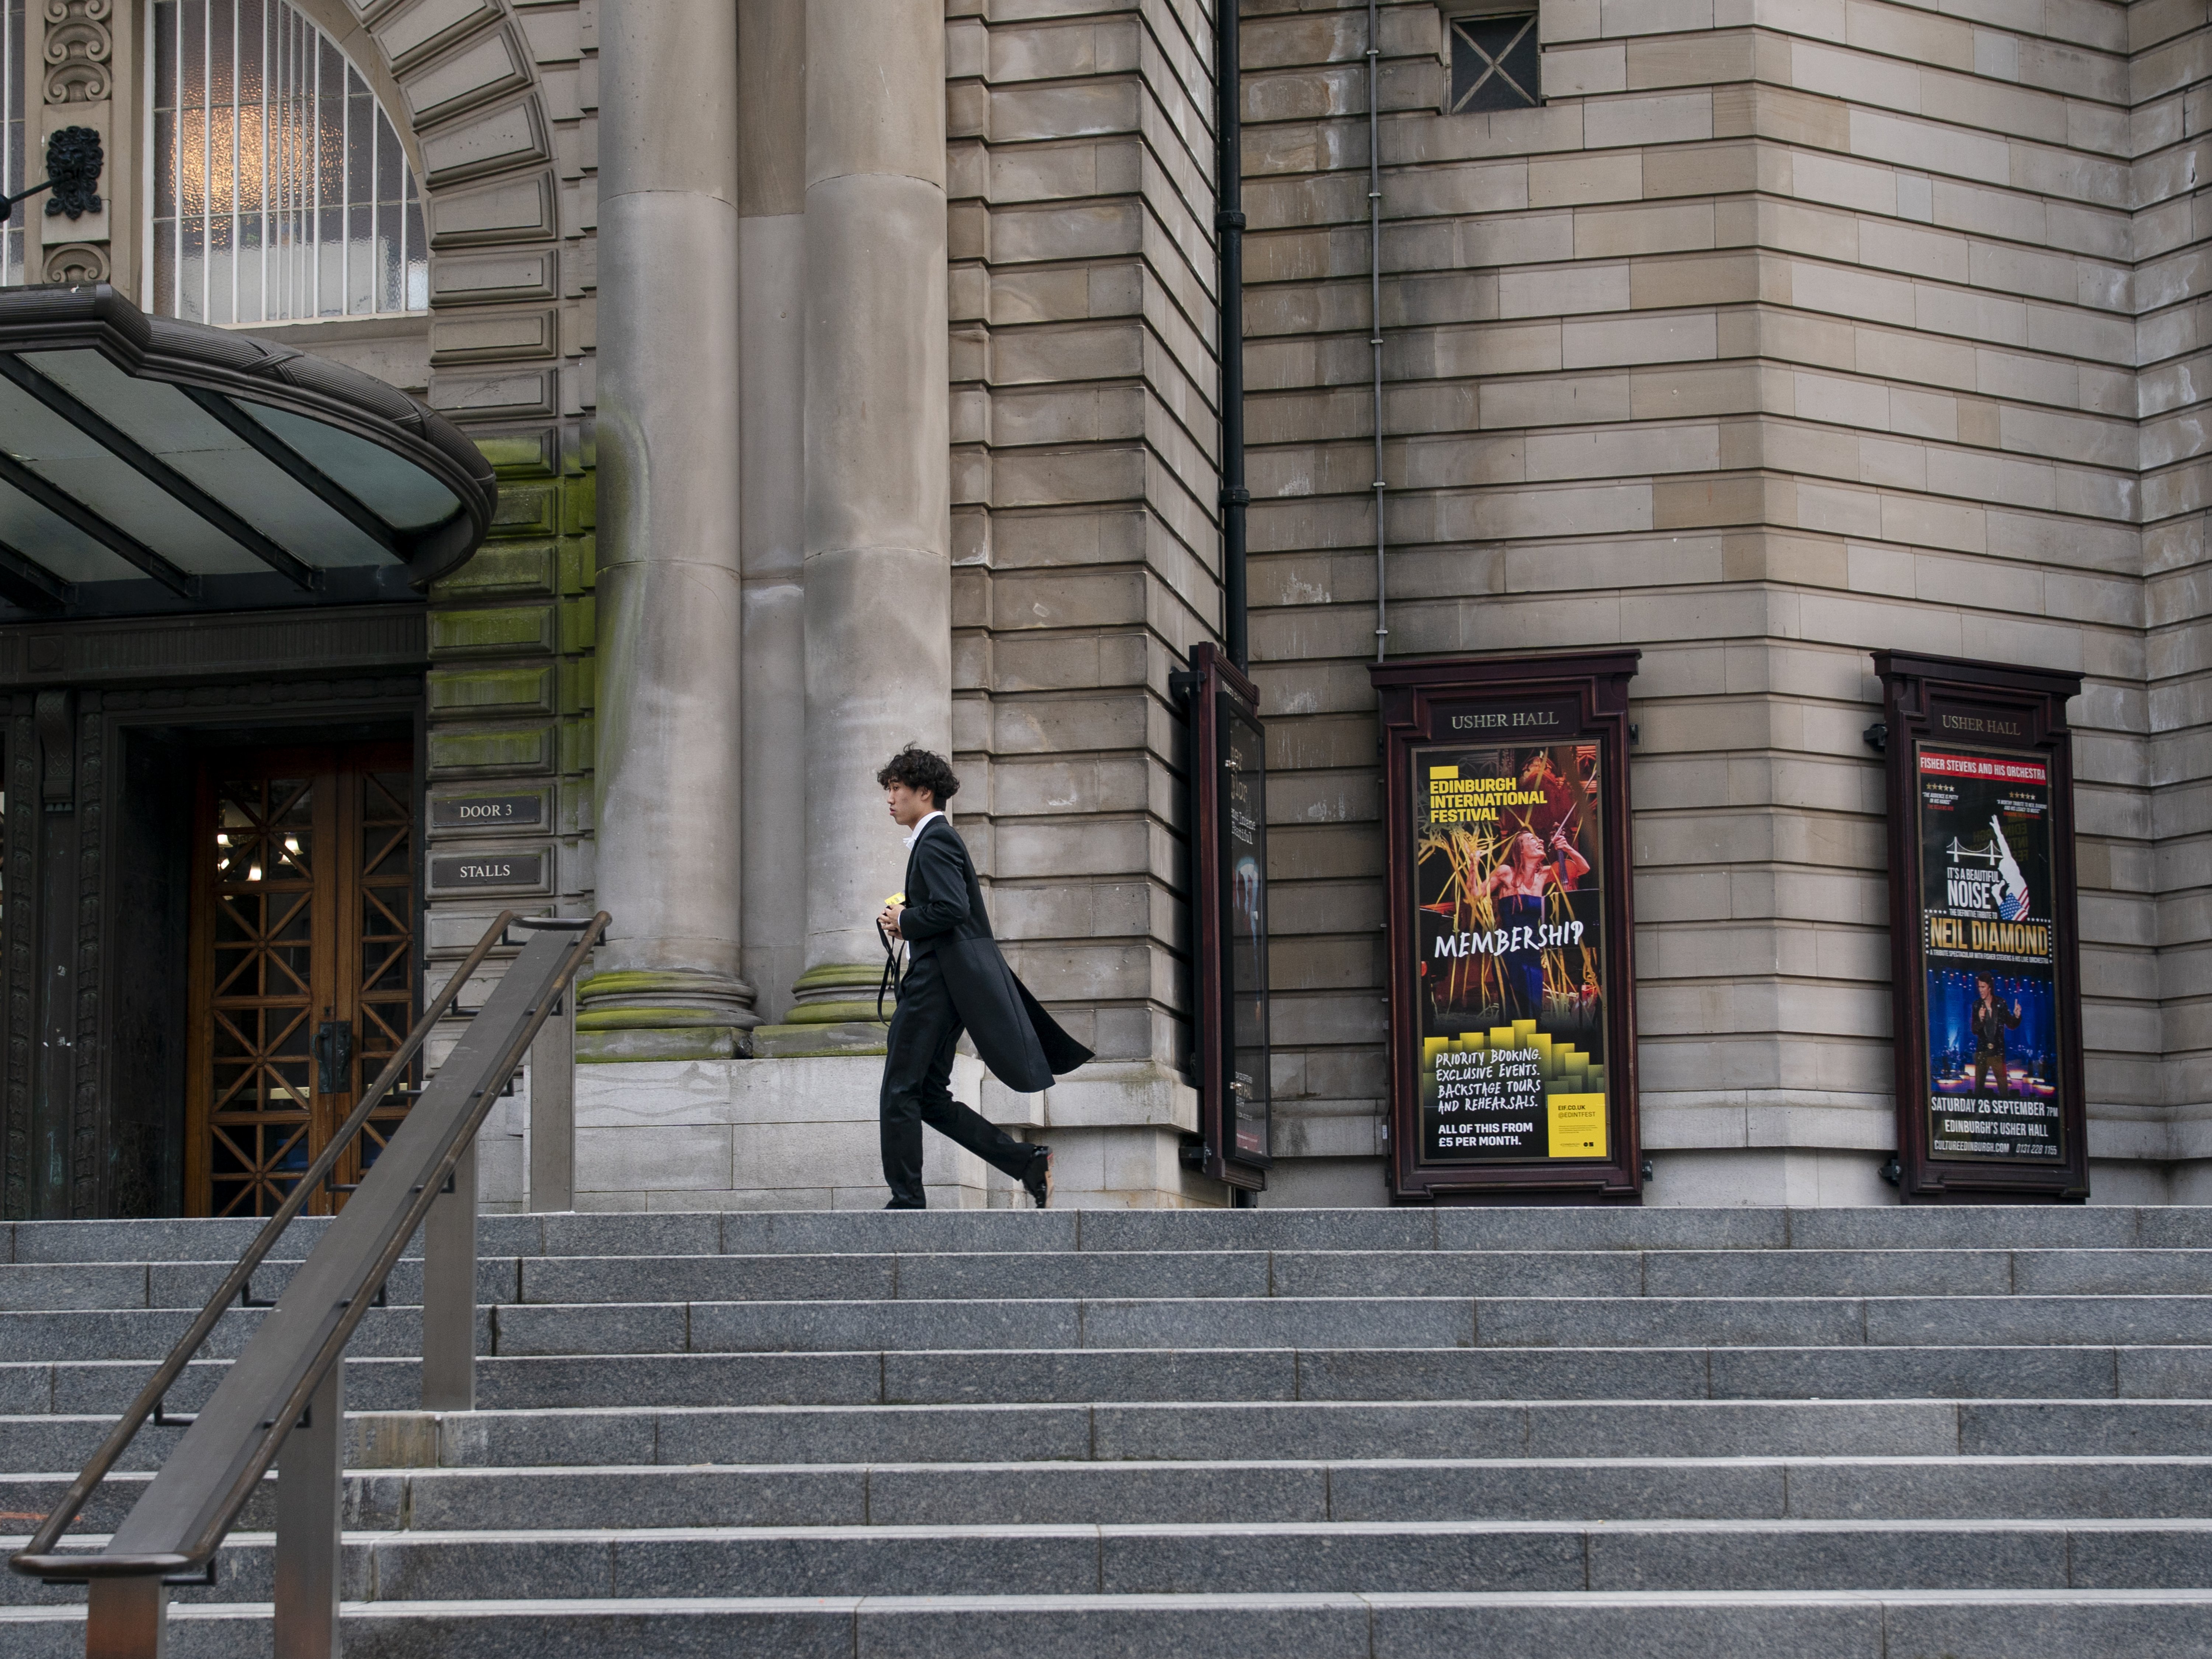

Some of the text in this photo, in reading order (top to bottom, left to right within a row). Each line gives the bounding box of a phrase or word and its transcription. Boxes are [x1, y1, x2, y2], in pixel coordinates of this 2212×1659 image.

[1451, 712, 1559, 729] USHER HALL
[1942, 715, 2021, 735] USHER HALL
[1920, 757, 2046, 780] FISHER STEVENS AND HIS ORCHESTRA
[1430, 777, 1516, 794] EDINBURGH
[1430, 791, 1547, 808] INTERNATIONAL
[460, 804, 512, 818] DOOR 3
[1431, 808, 1499, 823] FESTIVAL
[460, 865, 510, 878] STALLS
[1947, 867, 2000, 883] IT'S A BEAUTIFUL
[1948, 880, 1991, 909] NOISE
[1957, 909, 1976, 917] DEFINITIVE
[1976, 910, 1992, 919] TRIBUTE
[1434, 921, 1584, 958] MEMBERSHIP
[1931, 917, 2048, 955] NEIL DIAMOND
[1436, 1047, 1541, 1068] PRIORITY BOOKING.
[1436, 1063, 1540, 1081] EXCLUSIVE EVENTS.
[1437, 1079, 1541, 1098] BACKSTAGE TOURS
[1438, 1095, 1538, 1115] AND REHEARSALS.
[1931, 1097, 2058, 1117] SATURDAY 26 SEPTEMBER 7PM
[1439, 1122, 1533, 1134] ALL OF THIS FROM
[1945, 1119, 2048, 1137] EDINBURGH'S USHER HALL
[1439, 1136, 1521, 1147] £5 PER MONTH.
[1934, 1140, 2009, 1153] CULTUREEDINBURGH.COM
[2016, 1144, 2030, 1153] 0131
[2031, 1144, 2043, 1154] 228
[2044, 1146, 2057, 1155] 1155
